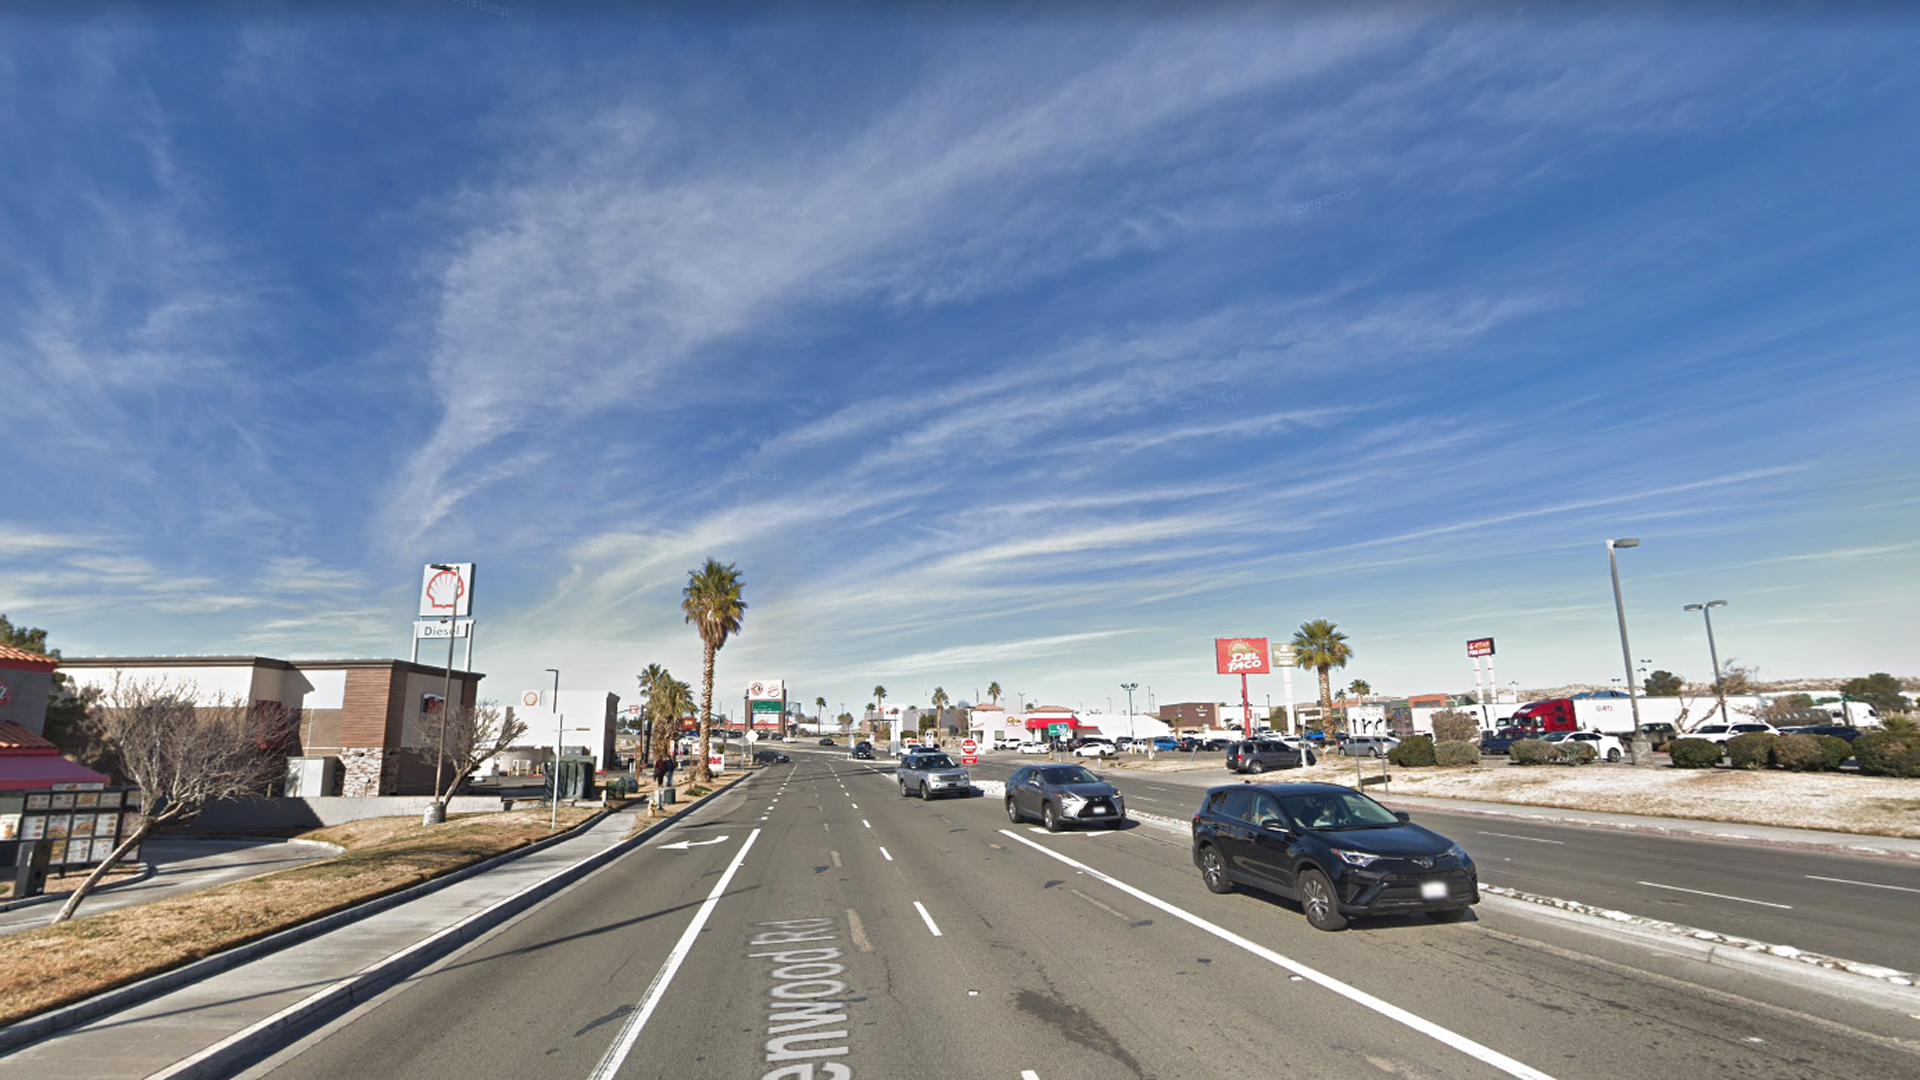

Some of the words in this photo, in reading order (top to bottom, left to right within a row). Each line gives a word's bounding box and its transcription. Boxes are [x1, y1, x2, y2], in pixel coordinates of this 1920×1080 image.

[424, 625, 460, 636] Diesel
[1232, 652, 1260, 662] DEL
[1227, 660, 1262, 673] TACO
